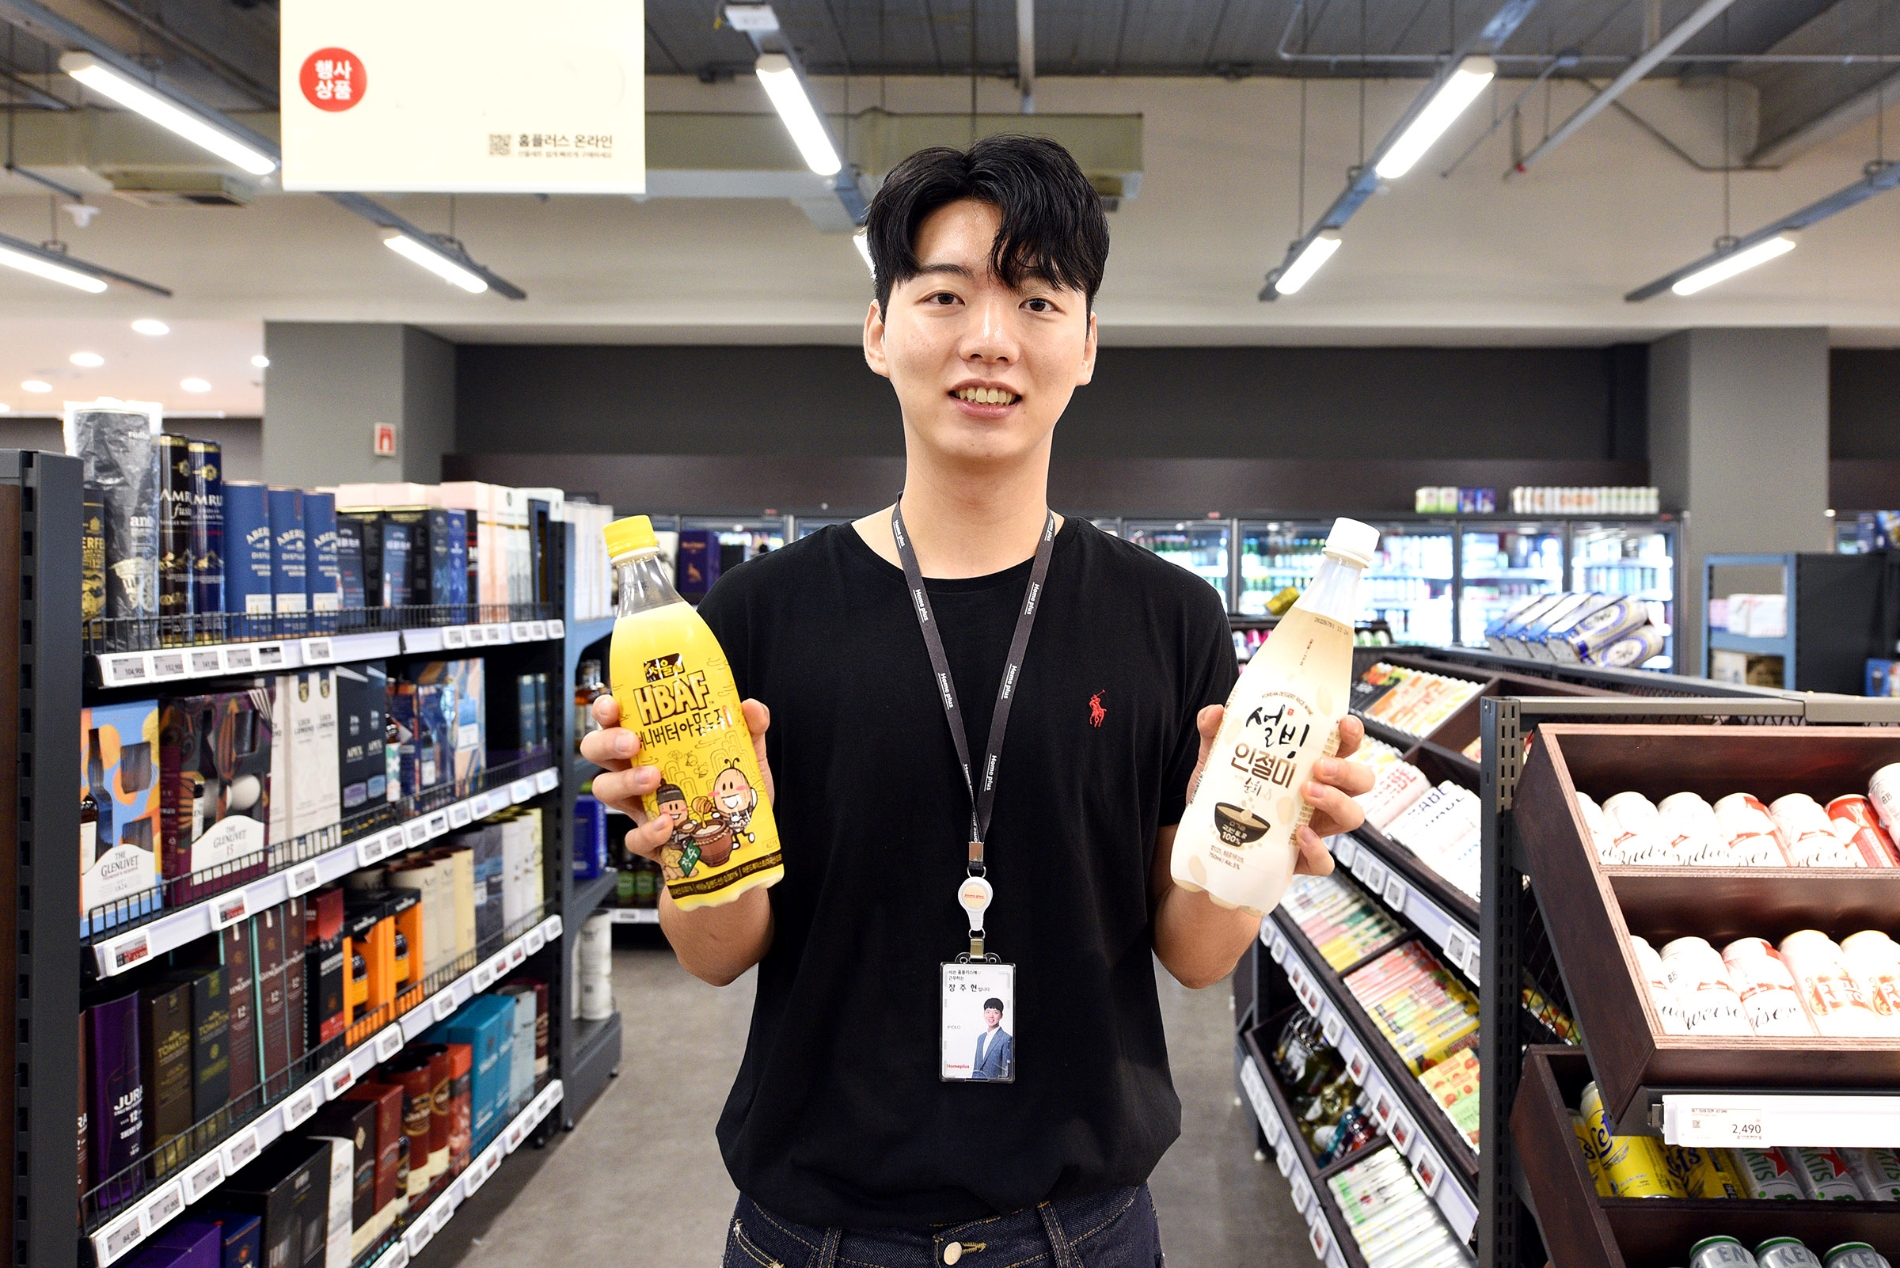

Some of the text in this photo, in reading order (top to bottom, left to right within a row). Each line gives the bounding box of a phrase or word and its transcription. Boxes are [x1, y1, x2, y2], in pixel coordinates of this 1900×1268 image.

[314, 59, 353, 80] 행사
[314, 80, 353, 101] 상품
[517, 133, 613, 149] 홈플러스 온라인
[915, 588, 929, 622] Home plus
[1026, 583, 1040, 616] Home plus
[940, 672, 954, 709] Home plus
[1004, 665, 1018, 700] Home plus
[633, 669, 710, 727] HBAF
[1245, 704, 1310, 760] 설빙
[986, 755, 998, 791] Home plus
[1230, 742, 1298, 789] 인절미
[212, 828, 247, 849] GLENLIVET
[224, 824, 236, 834] THE
[1221, 831, 1242, 846] 100%
[100, 855, 140, 877] GLENLIVET
[114, 850, 126, 861] THE
[1731, 1123, 1763, 1136] 2,490
